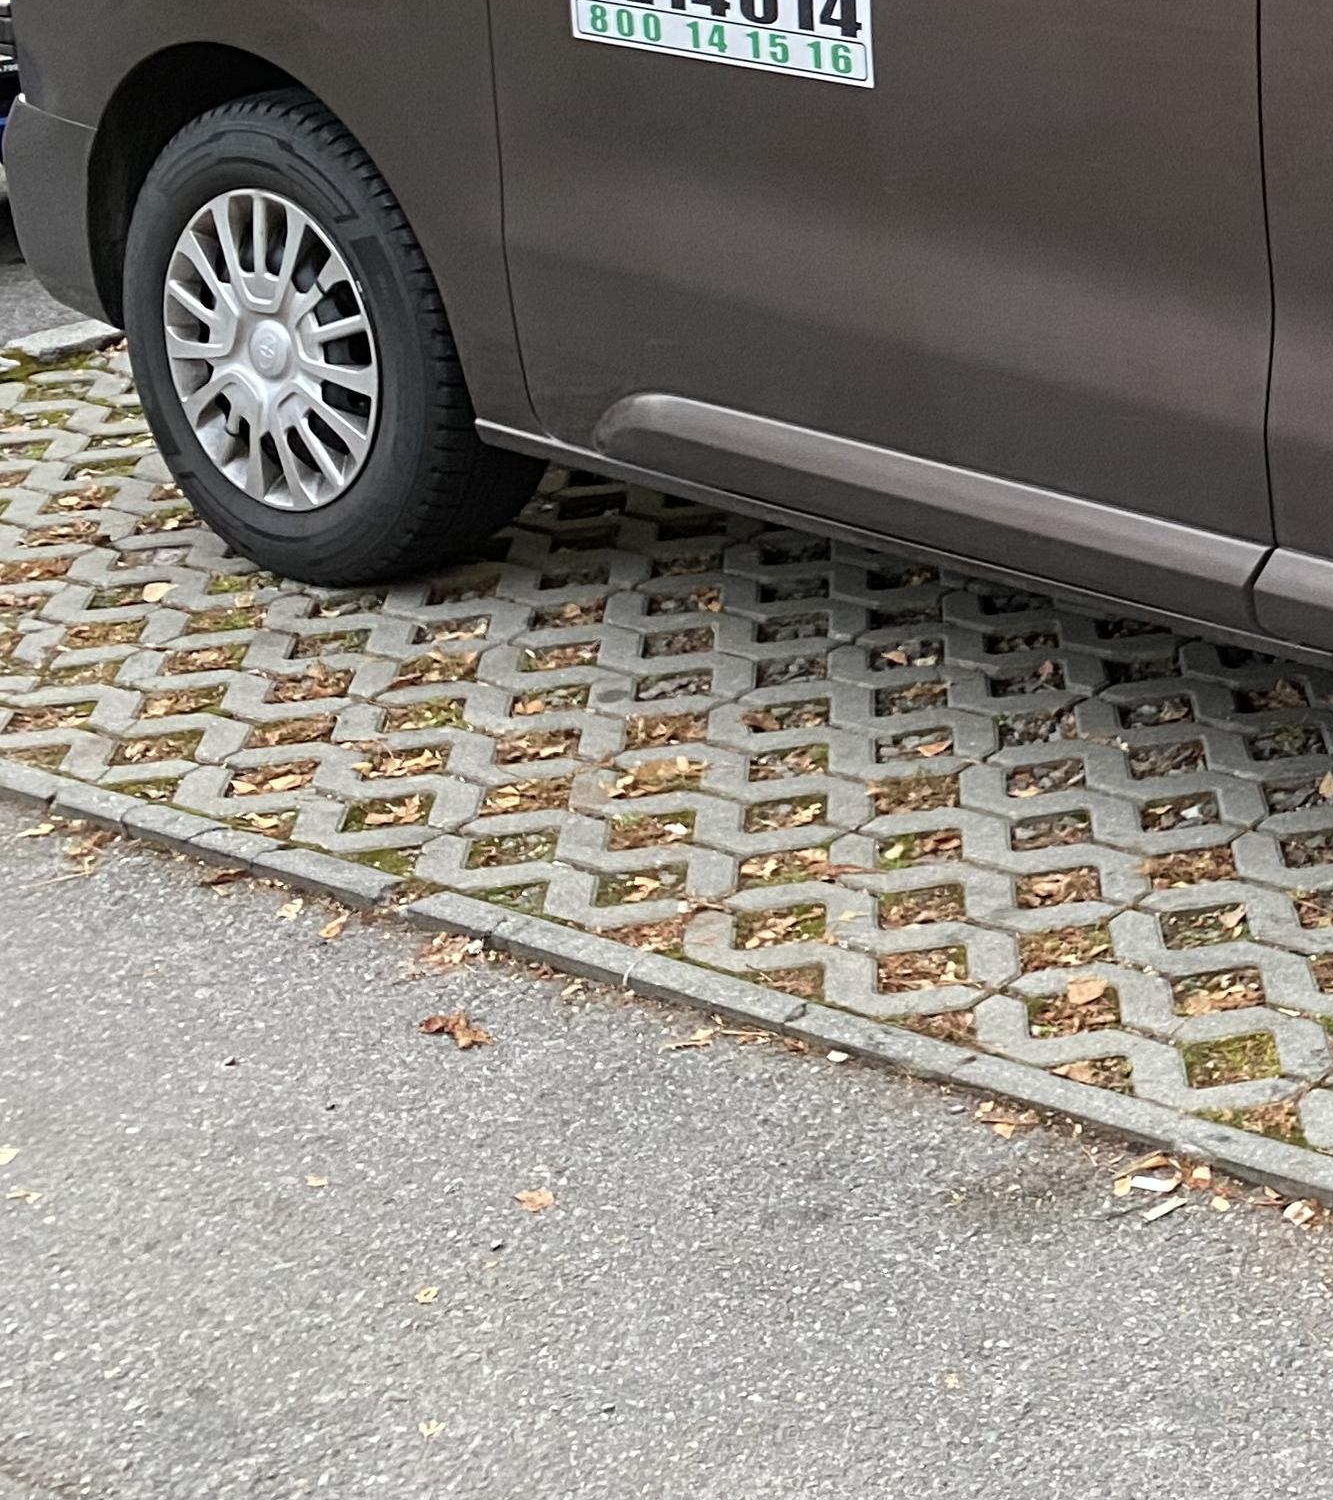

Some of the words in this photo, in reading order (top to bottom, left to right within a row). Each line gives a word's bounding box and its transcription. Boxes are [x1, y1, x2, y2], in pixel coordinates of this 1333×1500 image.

[589, 4, 661, 42] 800
[686, 21, 727, 53] 14
[747, 30, 789, 64] 15
[807, 41, 853, 74] 16
